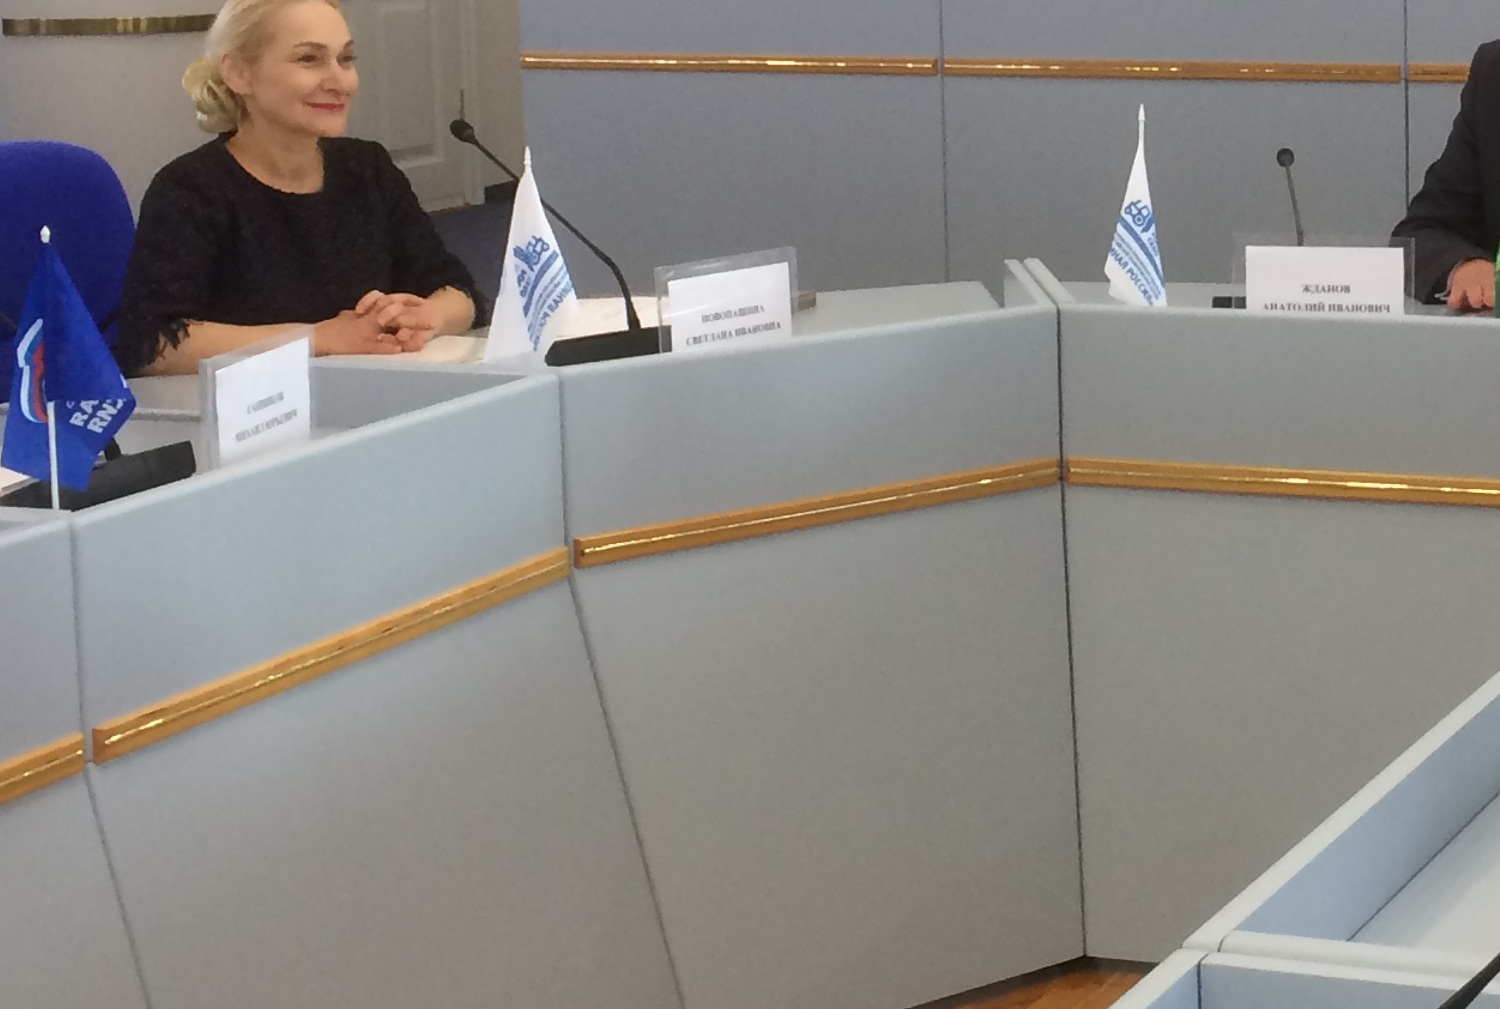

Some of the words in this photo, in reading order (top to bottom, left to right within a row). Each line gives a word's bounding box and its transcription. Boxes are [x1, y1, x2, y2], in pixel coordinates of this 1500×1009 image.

[1301, 284, 1351, 294] ЖДАНОВ
[1263, 302, 1325, 312] АНАТОЛИЙ
[1328, 303, 1390, 313] ИВАНОВИЧ
